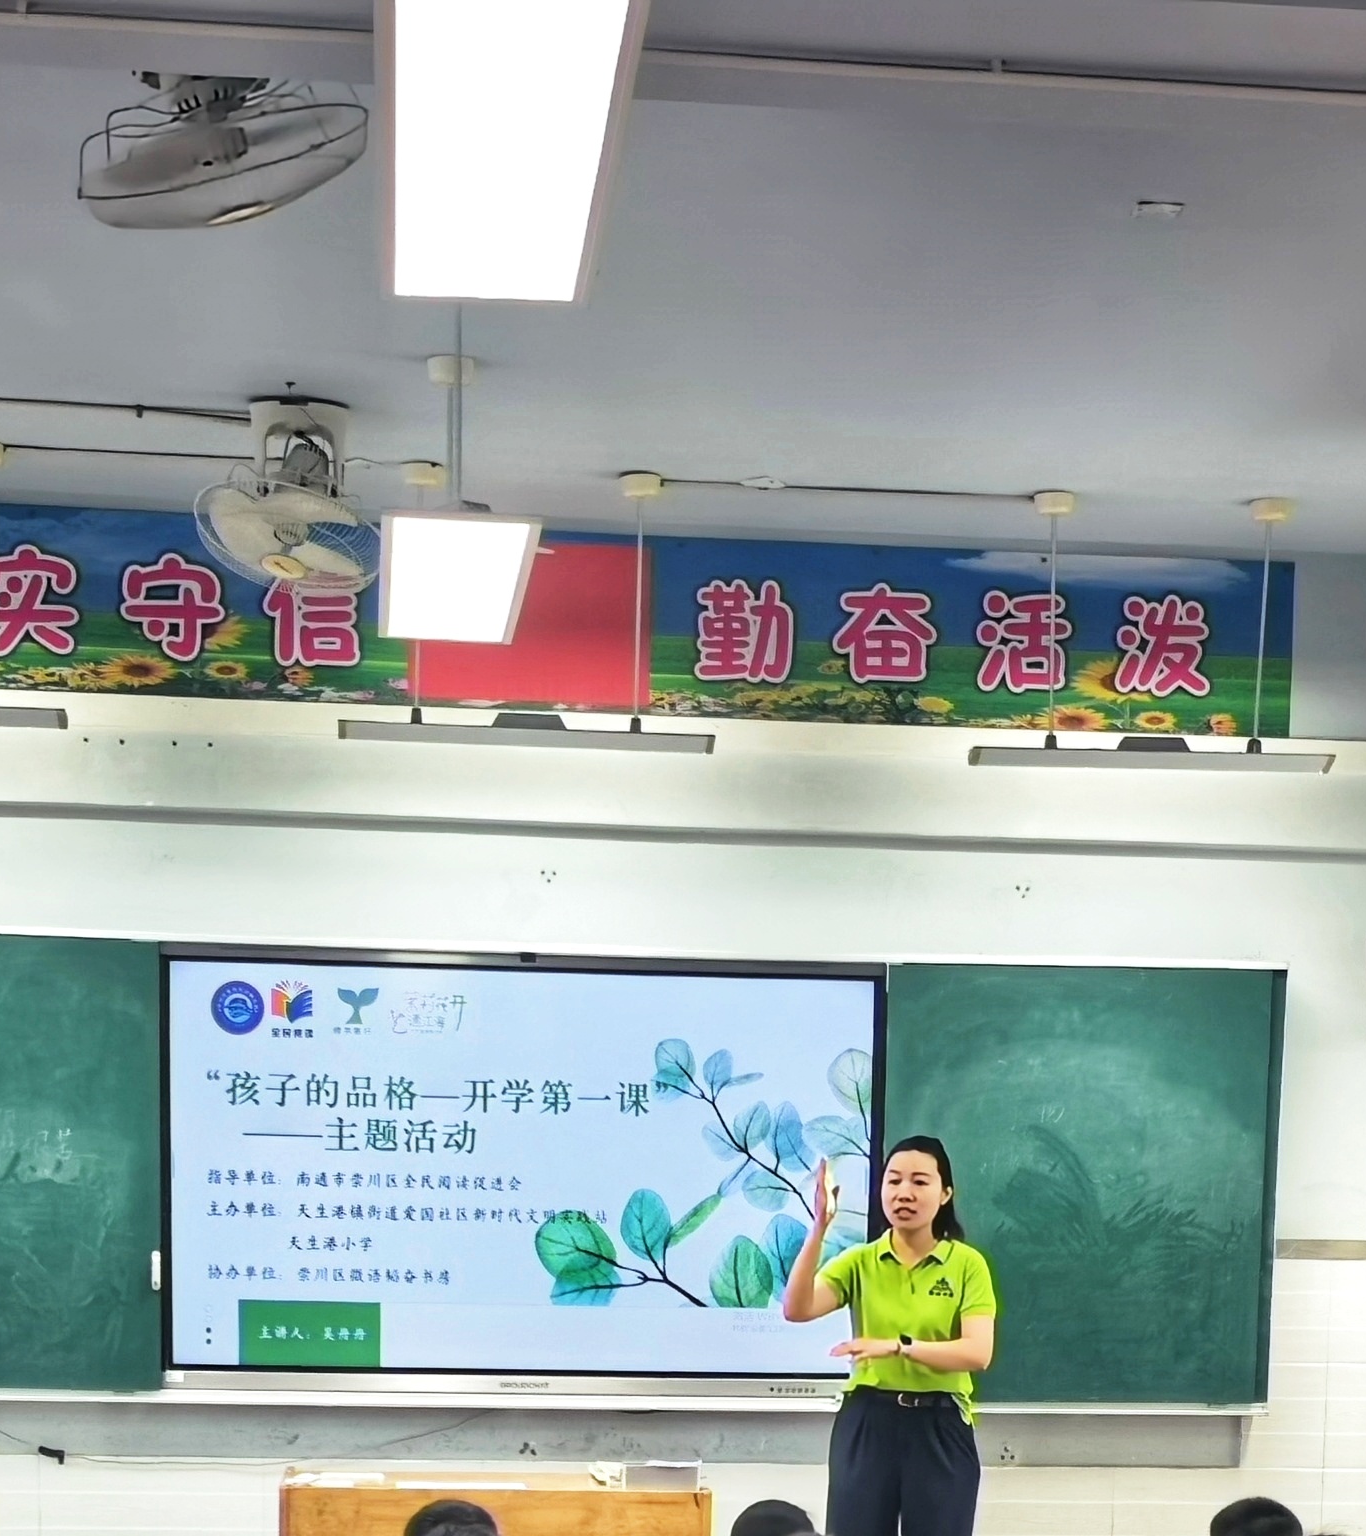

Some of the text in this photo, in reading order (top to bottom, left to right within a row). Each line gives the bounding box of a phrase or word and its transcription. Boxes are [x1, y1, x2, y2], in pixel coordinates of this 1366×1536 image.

[694, 579, 1212, 697] 勤奋活泼
[287, 1235, 373, 1252] 天生港小学
